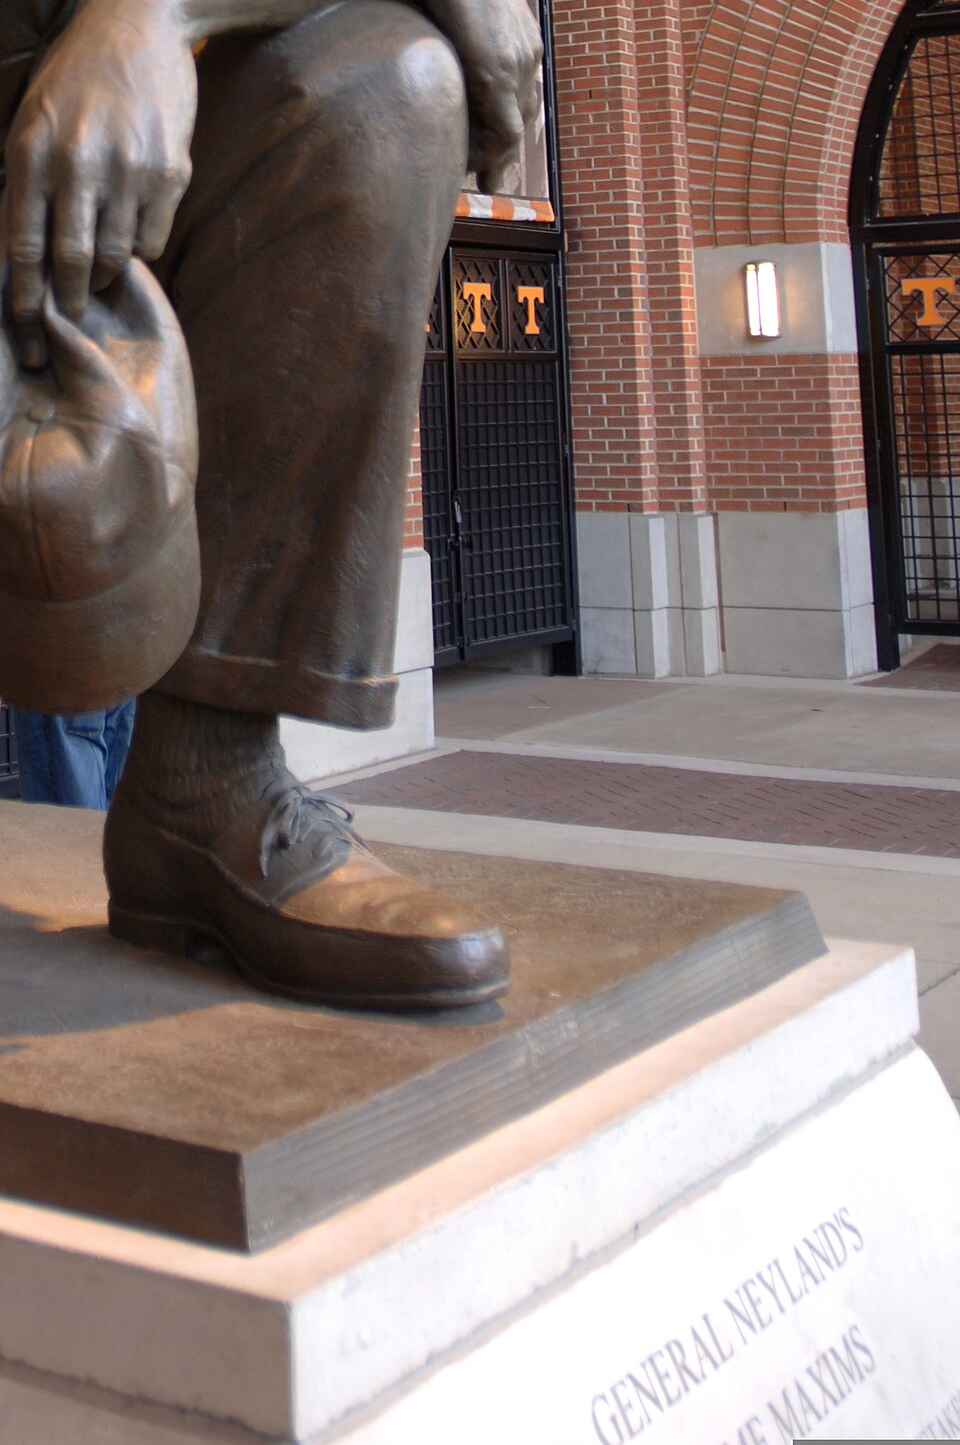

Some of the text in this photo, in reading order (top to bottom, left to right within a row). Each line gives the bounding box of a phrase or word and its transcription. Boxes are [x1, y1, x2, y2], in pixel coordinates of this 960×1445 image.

[463, 282, 491, 333] T
[518, 286, 544, 334] T
[901, 277, 956, 326] T
[591, 1207, 864, 1445] GENERAL NEYLAND'S
[767, 1325, 876, 1444] MAXIMS
